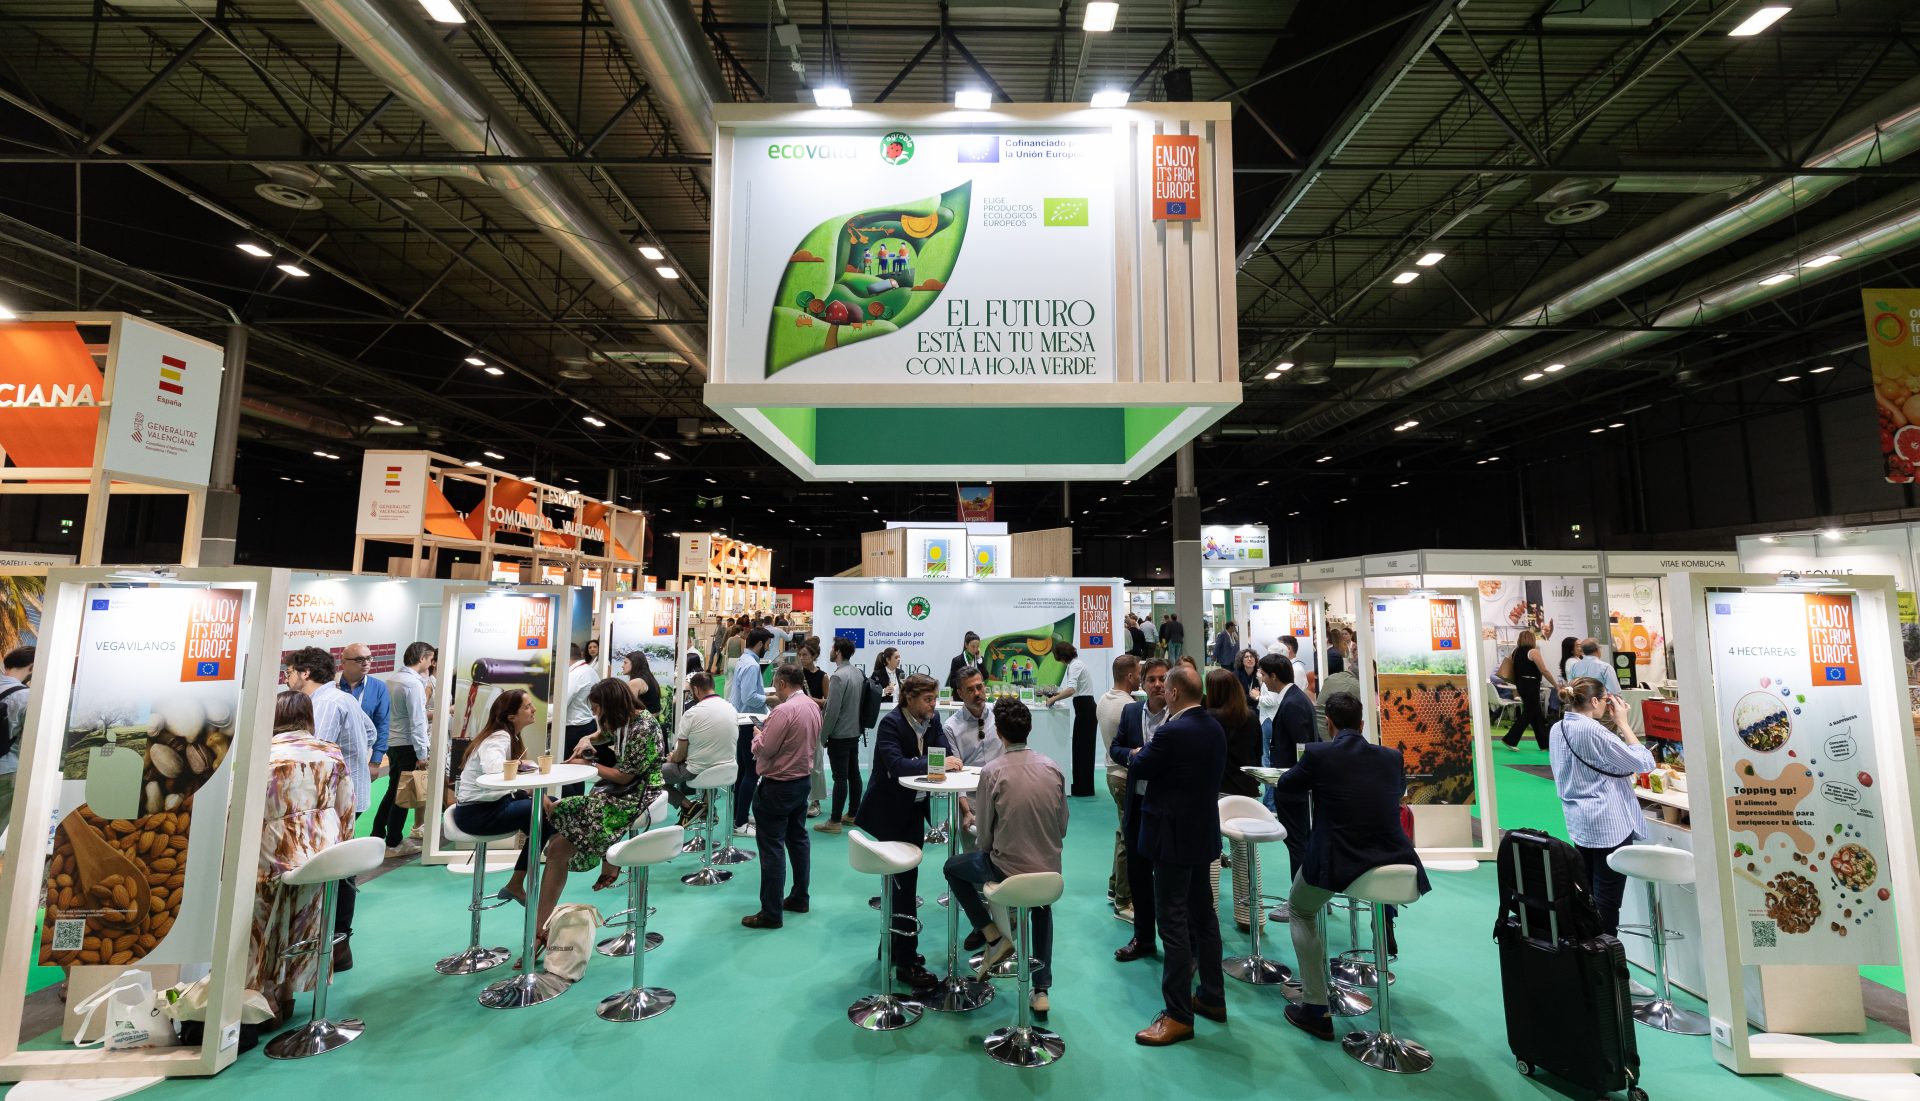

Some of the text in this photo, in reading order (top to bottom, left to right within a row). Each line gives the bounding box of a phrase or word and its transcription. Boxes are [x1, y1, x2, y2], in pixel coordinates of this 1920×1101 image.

[1005, 139, 1066, 147] Cofinanciado
[1016, 150, 1043, 158] Unión
[1046, 150, 1084, 161] Europe
[1156, 146, 1195, 167] ENJOY
[1157, 167, 1195, 181] IT'S FROM
[1156, 181, 1195, 199] EUROPE
[983, 204, 1033, 212] PRODUCTOS
[983, 219, 1027, 227] EUROPEOS
[947, 300, 1095, 326] EL FUTURO
[917, 327, 1096, 352] ESTÁ EN TU MESA
[906, 357, 1097, 375] CON LA HOJA VERDE
[157, 395, 182, 408] España
[147, 422, 198, 439] GENERALITAT
[147, 431, 195, 447] VALENCIANA
[487, 505, 553, 530] COMUNIDAD
[562, 519, 604, 541] VALENCIANA
[833, 601, 893, 616] ecovalia
[1082, 594, 1110, 610] ENJOY
[192, 599, 239, 622] ENJOY
[309, 611, 374, 624] VALENCIANA
[1082, 610, 1108, 620] IT'S FROM
[1431, 604, 1456, 618] ENJOY
[1807, 604, 1849, 628] ENJOY
[1082, 621, 1110, 634] EUROPE
[1442, 617, 1456, 627] FROM
[190, 622, 234, 639] IT'S FROM
[521, 625, 546, 637] EUROPE
[913, 631, 925, 640] por
[1433, 626, 1457, 638] EUROPE
[1811, 628, 1851, 645] IT'S FROM
[95, 641, 176, 651] VEGAVILANOS
[188, 639, 232, 659] EUROPE
[897, 639, 925, 647] Europea
[1728, 646, 1797, 657] 4 HECTAREAS
[1813, 644, 1855, 664] EUROPE
[1734, 786, 1797, 796] Topping up!
